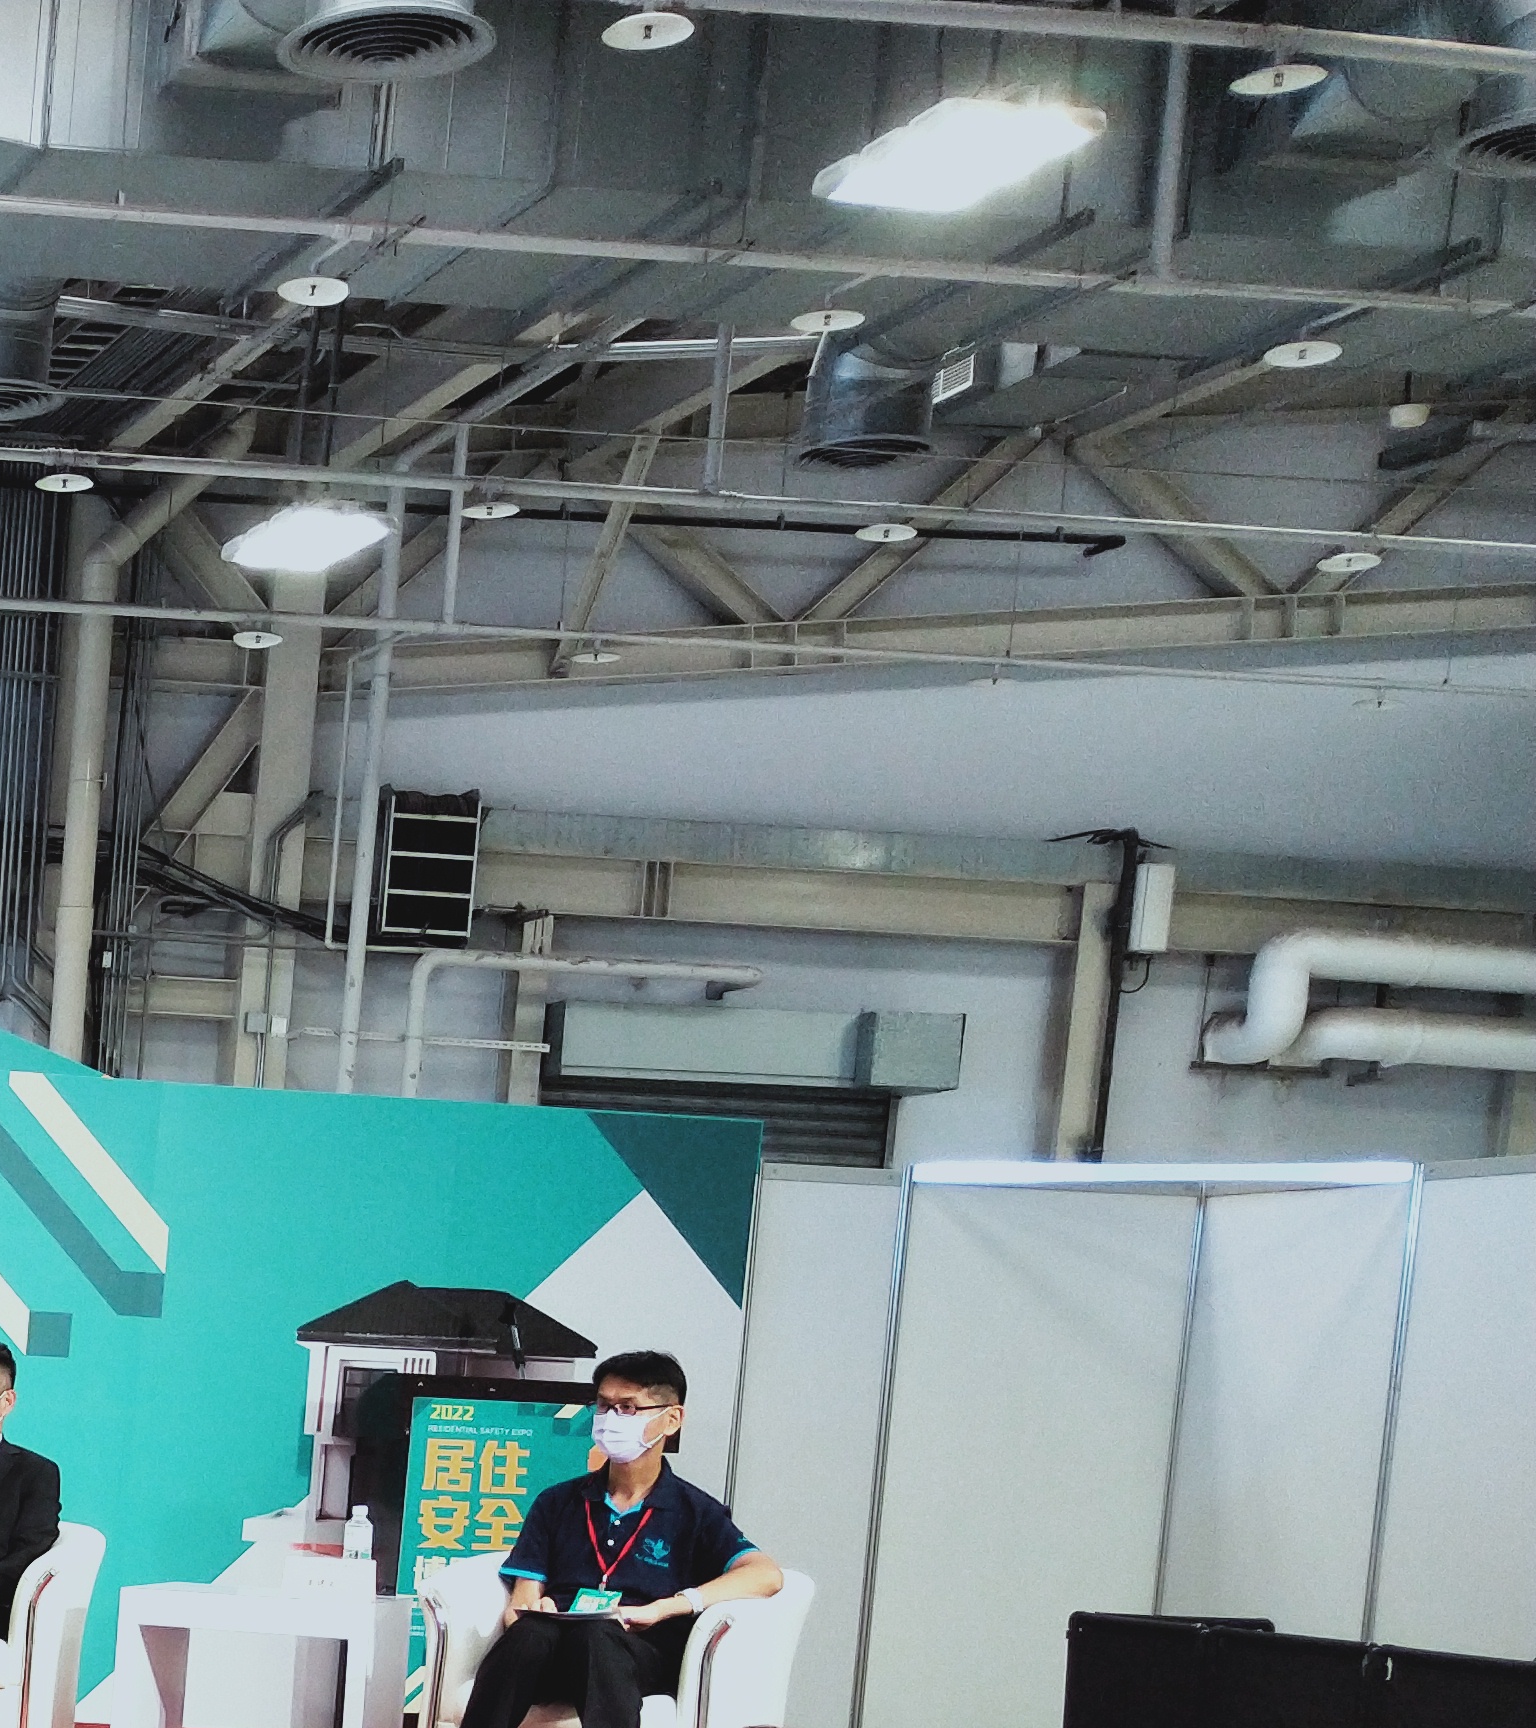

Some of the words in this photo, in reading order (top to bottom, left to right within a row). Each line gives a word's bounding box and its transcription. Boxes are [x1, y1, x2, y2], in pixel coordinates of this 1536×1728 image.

[430, 1404, 475, 1421] 2022
[421, 1438, 530, 1494] 居住
[417, 1496, 525, 1551] 安全
